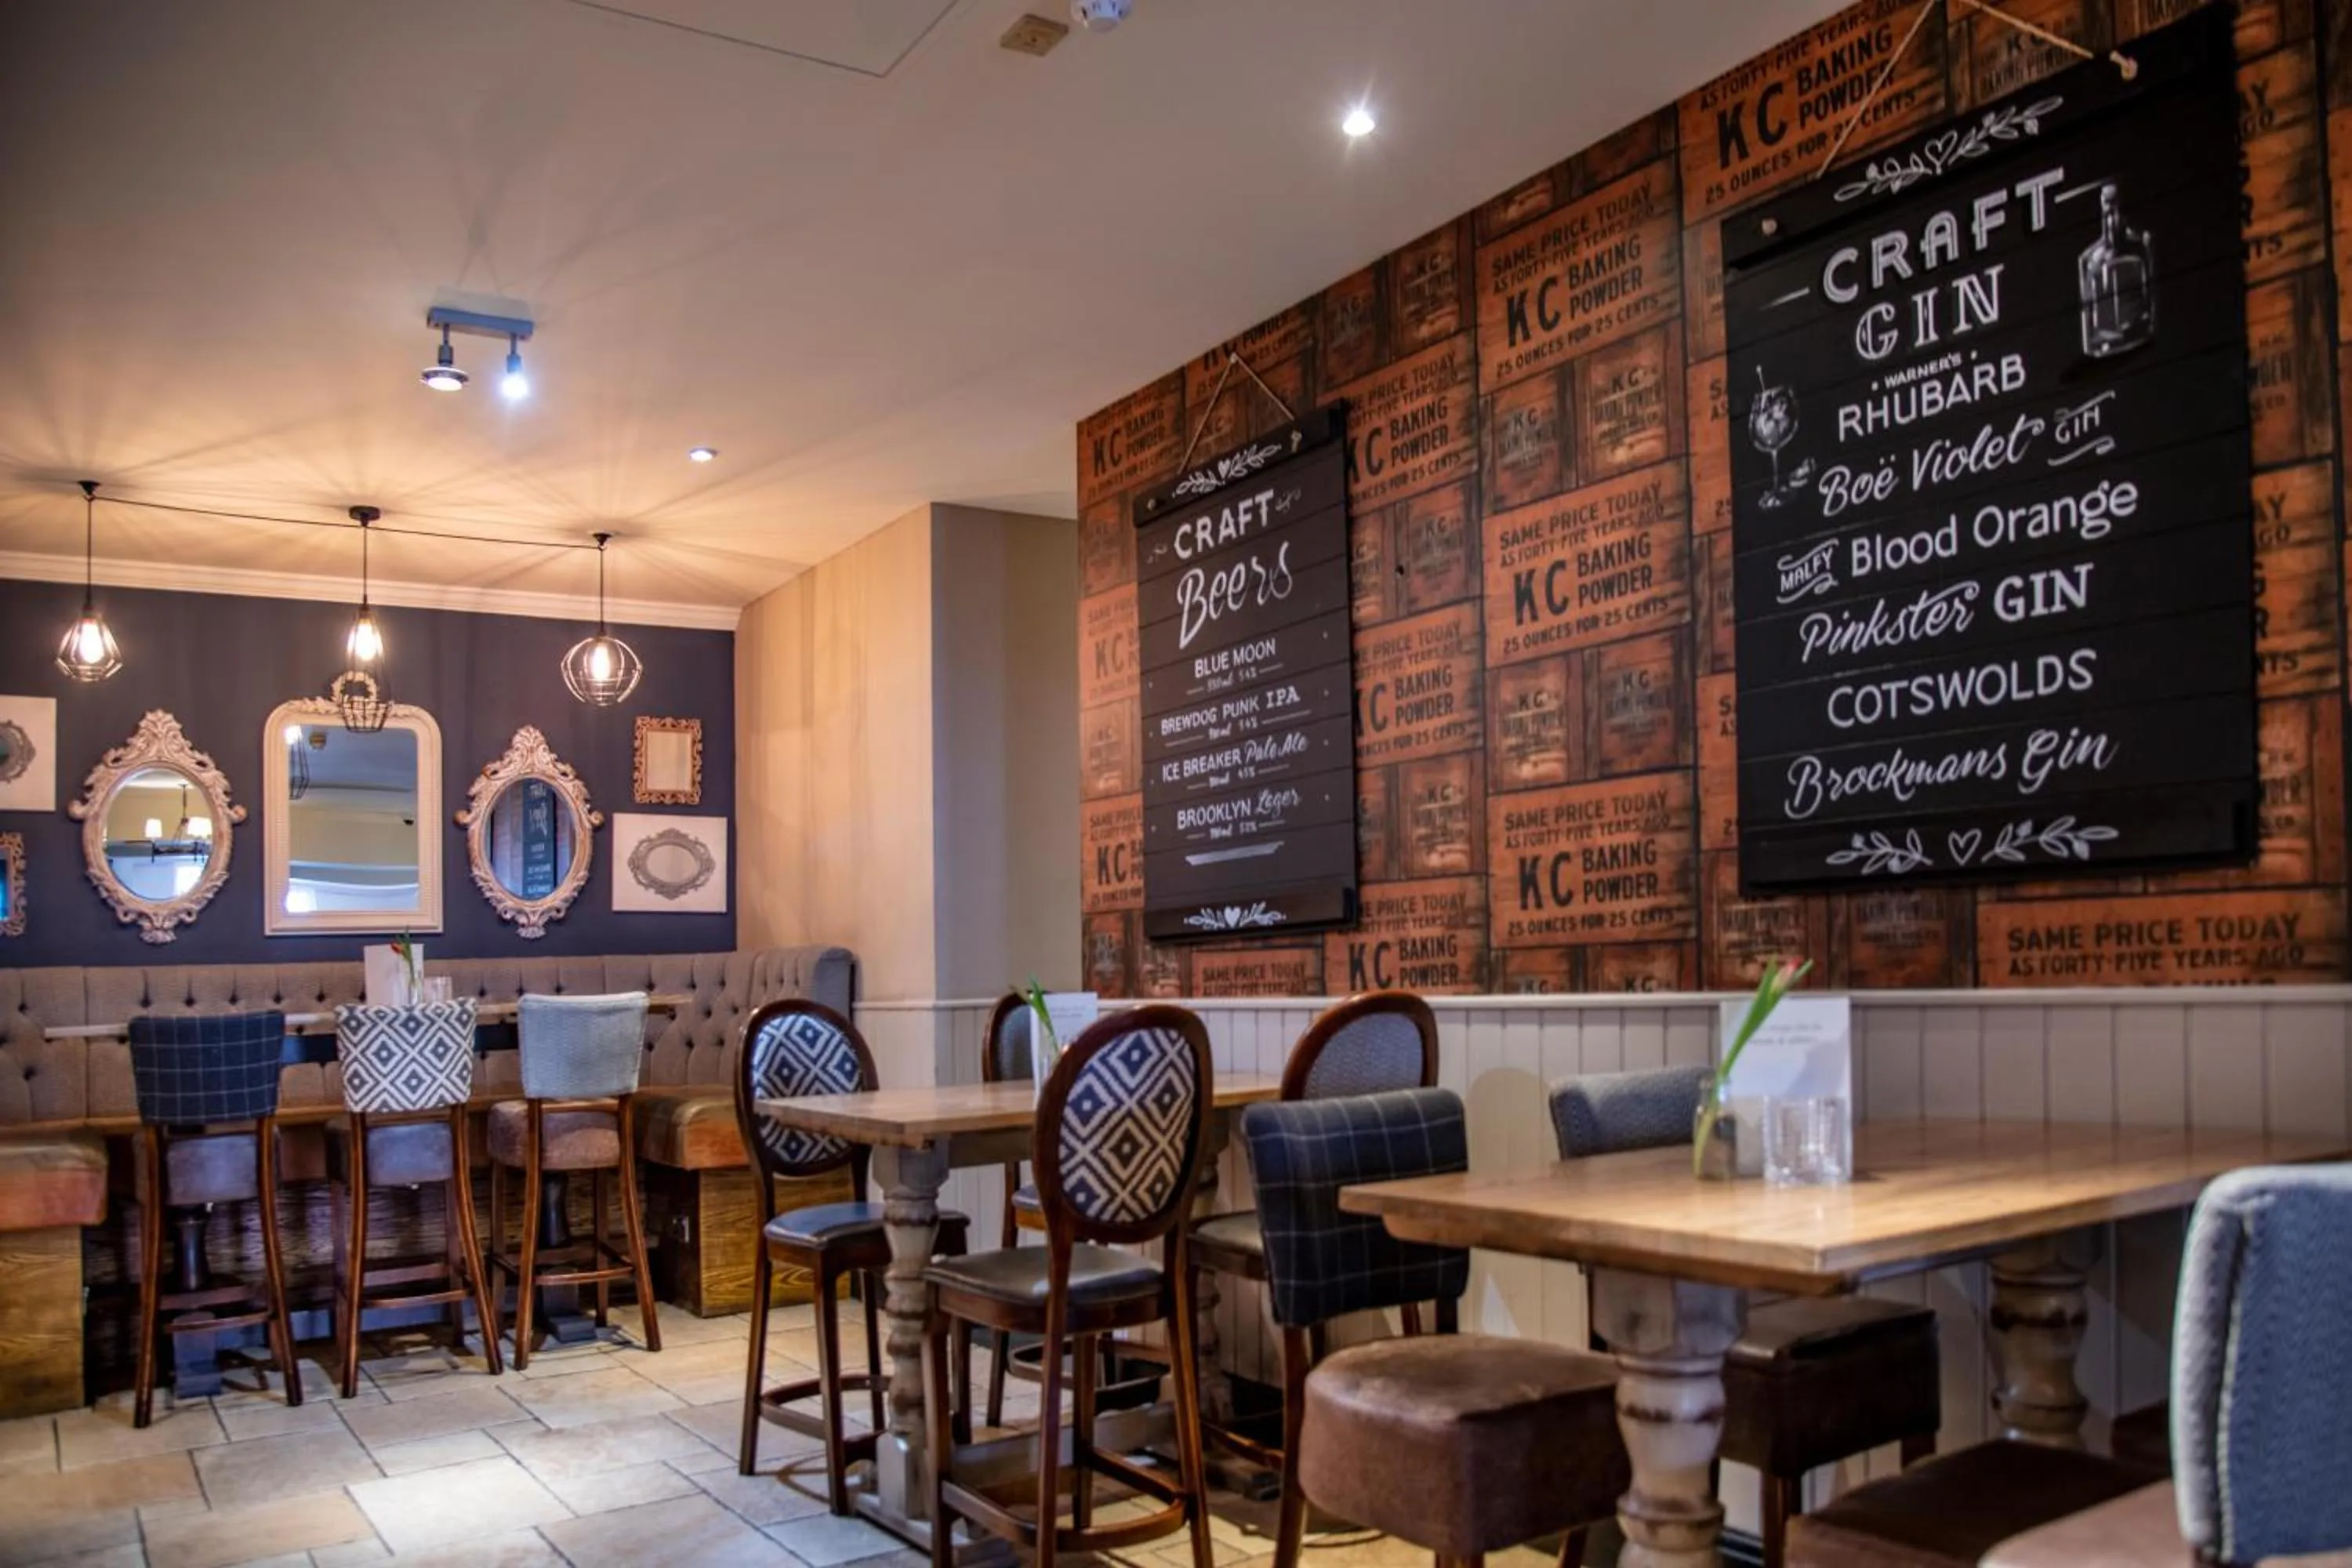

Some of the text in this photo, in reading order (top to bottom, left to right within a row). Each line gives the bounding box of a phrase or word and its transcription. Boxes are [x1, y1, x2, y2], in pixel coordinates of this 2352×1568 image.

[1796, 21, 1894, 97] BAKING
[1716, 82, 1788, 170] KC
[1730, 148, 1792, 192] OUNCES
[1492, 181, 1653, 274] SAME PRICE TODAY
[1823, 168, 2063, 303] CRAFT
[1568, 233, 1642, 290] BAKING
[1506, 276, 1562, 349] KC
[1570, 266, 1643, 321] POWDER
[1856, 264, 2004, 361] GIN
[1515, 335, 1566, 371] OUNCES
[1389, 395, 1448, 441] BAKING
[1838, 355, 2026, 441] RHUBARB
[1391, 424, 1449, 468] POWDER
[1912, 413, 2045, 492] Violet
[1174, 489, 1274, 559] CRAFT
[1499, 479, 1662, 551] SAME PRICE TODAY
[1780, 481, 2138, 593] MALFY Blood Orange
[1501, 551, 1516, 568] AS
[1577, 531, 1652, 578] BAKING
[1178, 542, 1293, 649] Beers
[1513, 559, 1570, 626] KC
[1577, 564, 1654, 608] POWDER
[1503, 638, 1519, 655] 25
[1523, 622, 1572, 649] OUNCES
[1604, 608, 1623, 626] 25
[1800, 564, 2094, 662] Pinkster GIN
[1194, 637, 1276, 678] BLUE MOON
[1394, 665, 1453, 700] BAKING
[1828, 649, 2098, 728] COTSWOLDS
[1161, 707, 1217, 735] BREWDOG
[1222, 695, 1260, 720] PUNK
[1266, 685, 1301, 709] IPA
[1396, 692, 1454, 728] POWDER
[1163, 762, 1181, 782] ICE
[1183, 748, 1243, 777] BREAKER
[1244, 735, 1276, 764] Pale
[1785, 728, 2119, 819] Brockmans Gin
[1178, 798, 1251, 830] BROOKLYN
[1504, 788, 1670, 832] SAME PRICE TODAY
[1098, 843, 1127, 886] KC
[1505, 835, 1519, 849] AS
[1581, 837, 1657, 874] BAKING
[1519, 851, 1574, 911] KC
[1583, 872, 1659, 904] POWDER
[1399, 933, 1457, 962] BAKING
[1508, 920, 1525, 938] 25
[1530, 915, 1578, 934] OUNCES
[1610, 910, 1627, 928] 25
[2008, 911, 2303, 953] SAME PRICE TODAY
[1348, 941, 1392, 992] KC
[1399, 964, 1459, 989] POWDER
[2009, 955, 2034, 978] AS
[2174, 947, 2248, 970] YEARS
